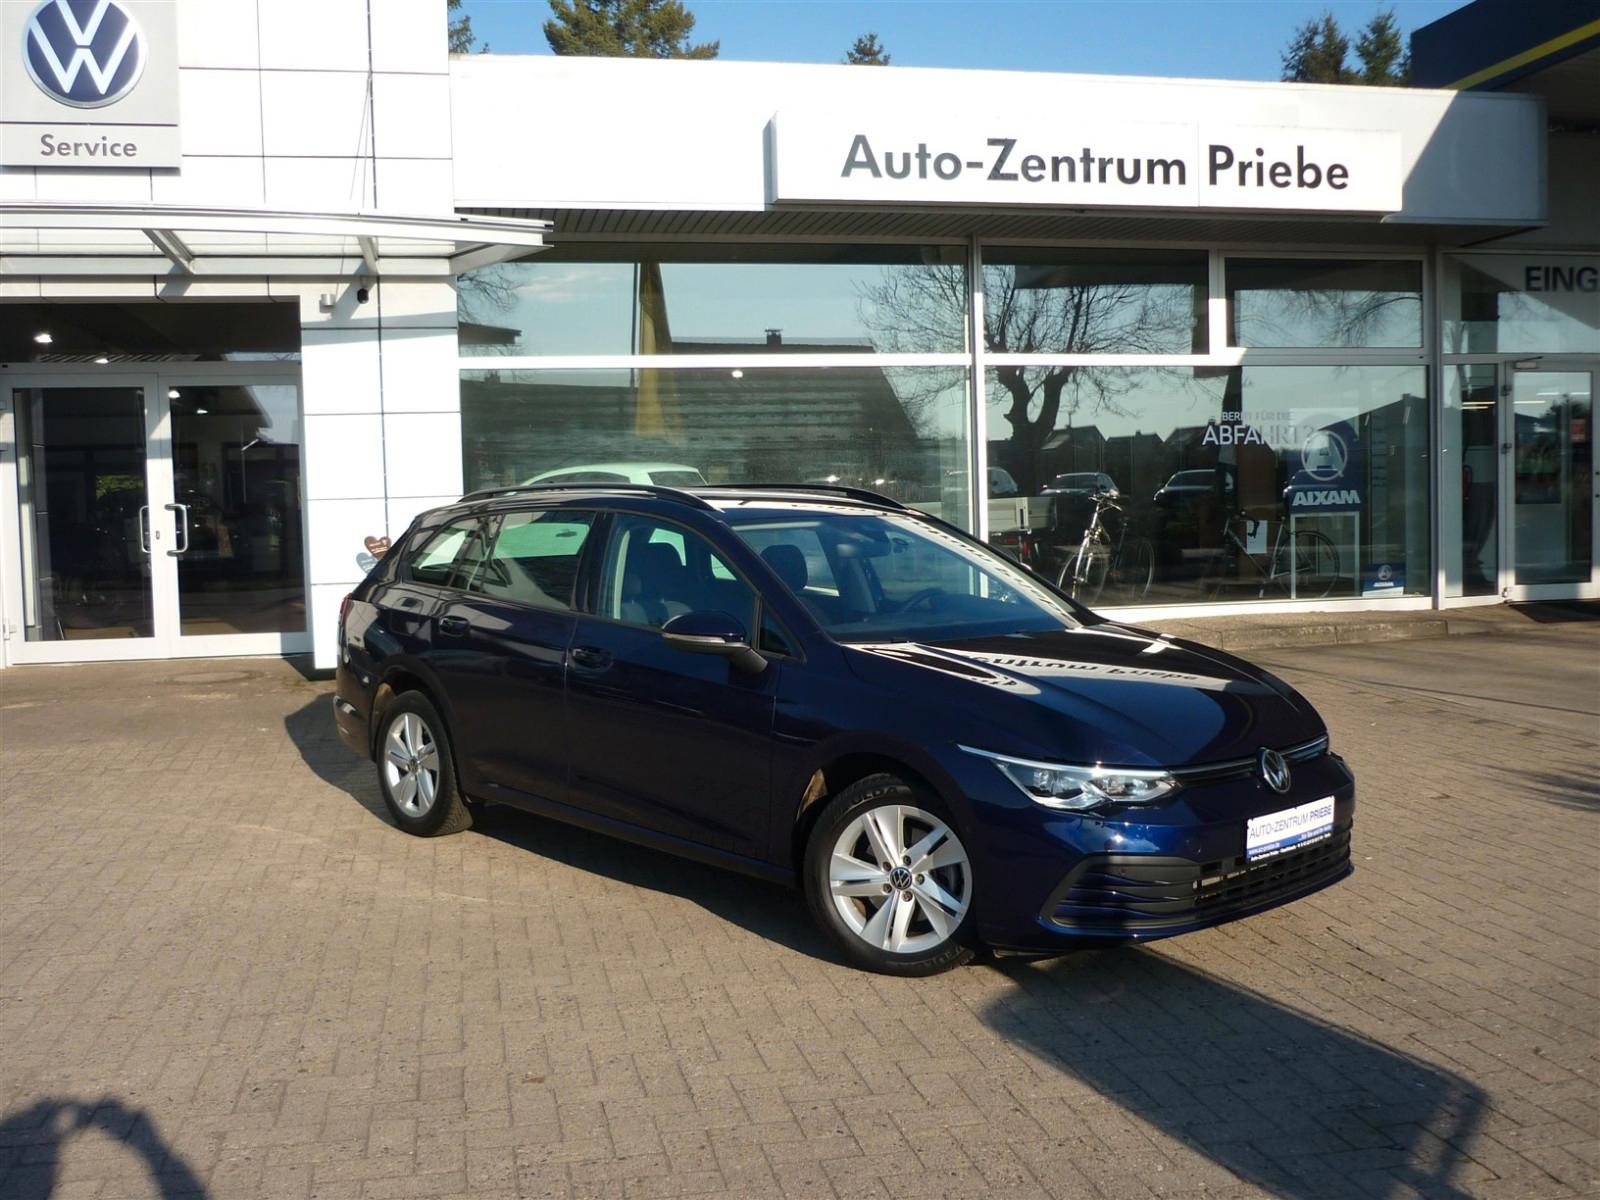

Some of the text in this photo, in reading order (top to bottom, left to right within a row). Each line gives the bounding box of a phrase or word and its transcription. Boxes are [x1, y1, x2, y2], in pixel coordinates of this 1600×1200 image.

[40, 133, 138, 157] Service
[840, 133, 1350, 191] Auto-Zentrum Priebe
[1524, 265, 1600, 292] EING
[1221, 411, 1253, 421] BERIT
[1292, 489, 1361, 506] AIXAM
[1249, 812, 1309, 840] AUTO-ZENTRUM
[1309, 804, 1333, 822] PRIEBE
